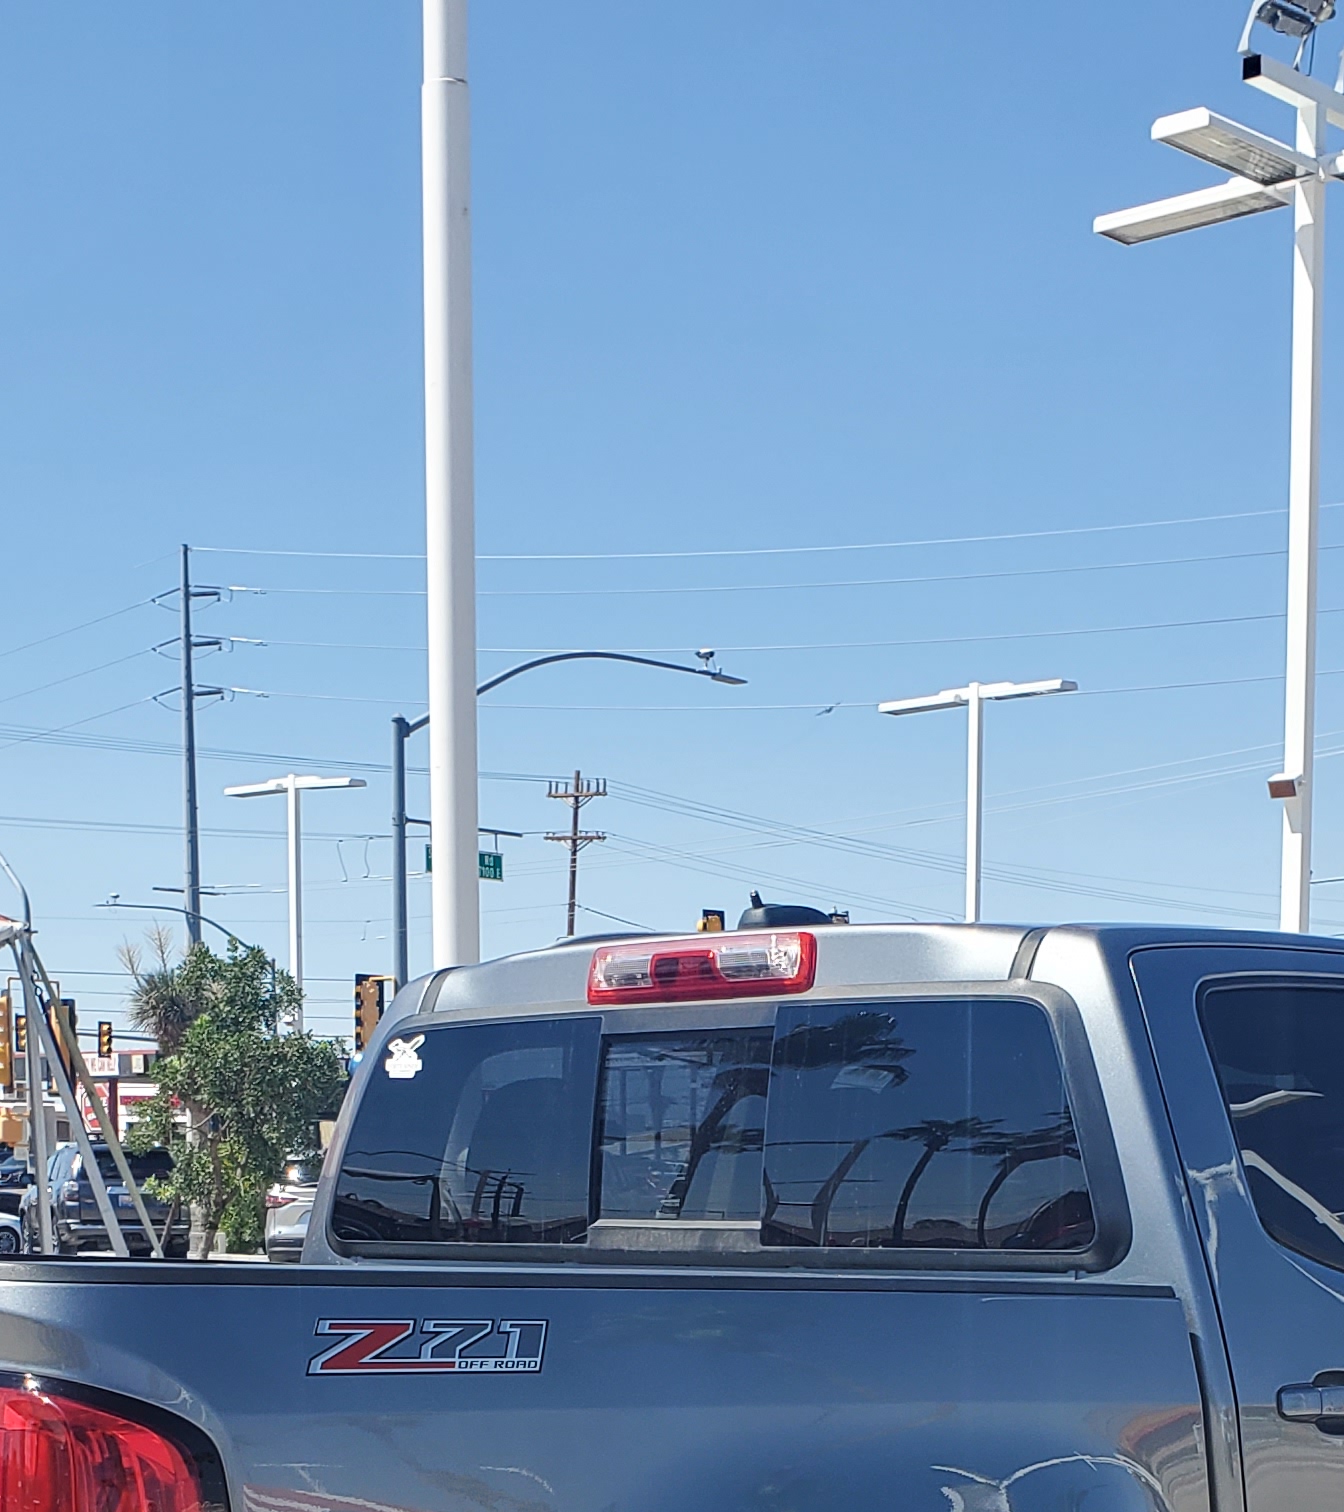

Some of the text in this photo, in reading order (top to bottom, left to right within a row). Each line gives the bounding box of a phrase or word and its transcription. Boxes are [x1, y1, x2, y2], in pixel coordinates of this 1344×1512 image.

[306, 1317, 549, 1376] Z71
[459, 1360, 538, 1369] OFF ROAD
